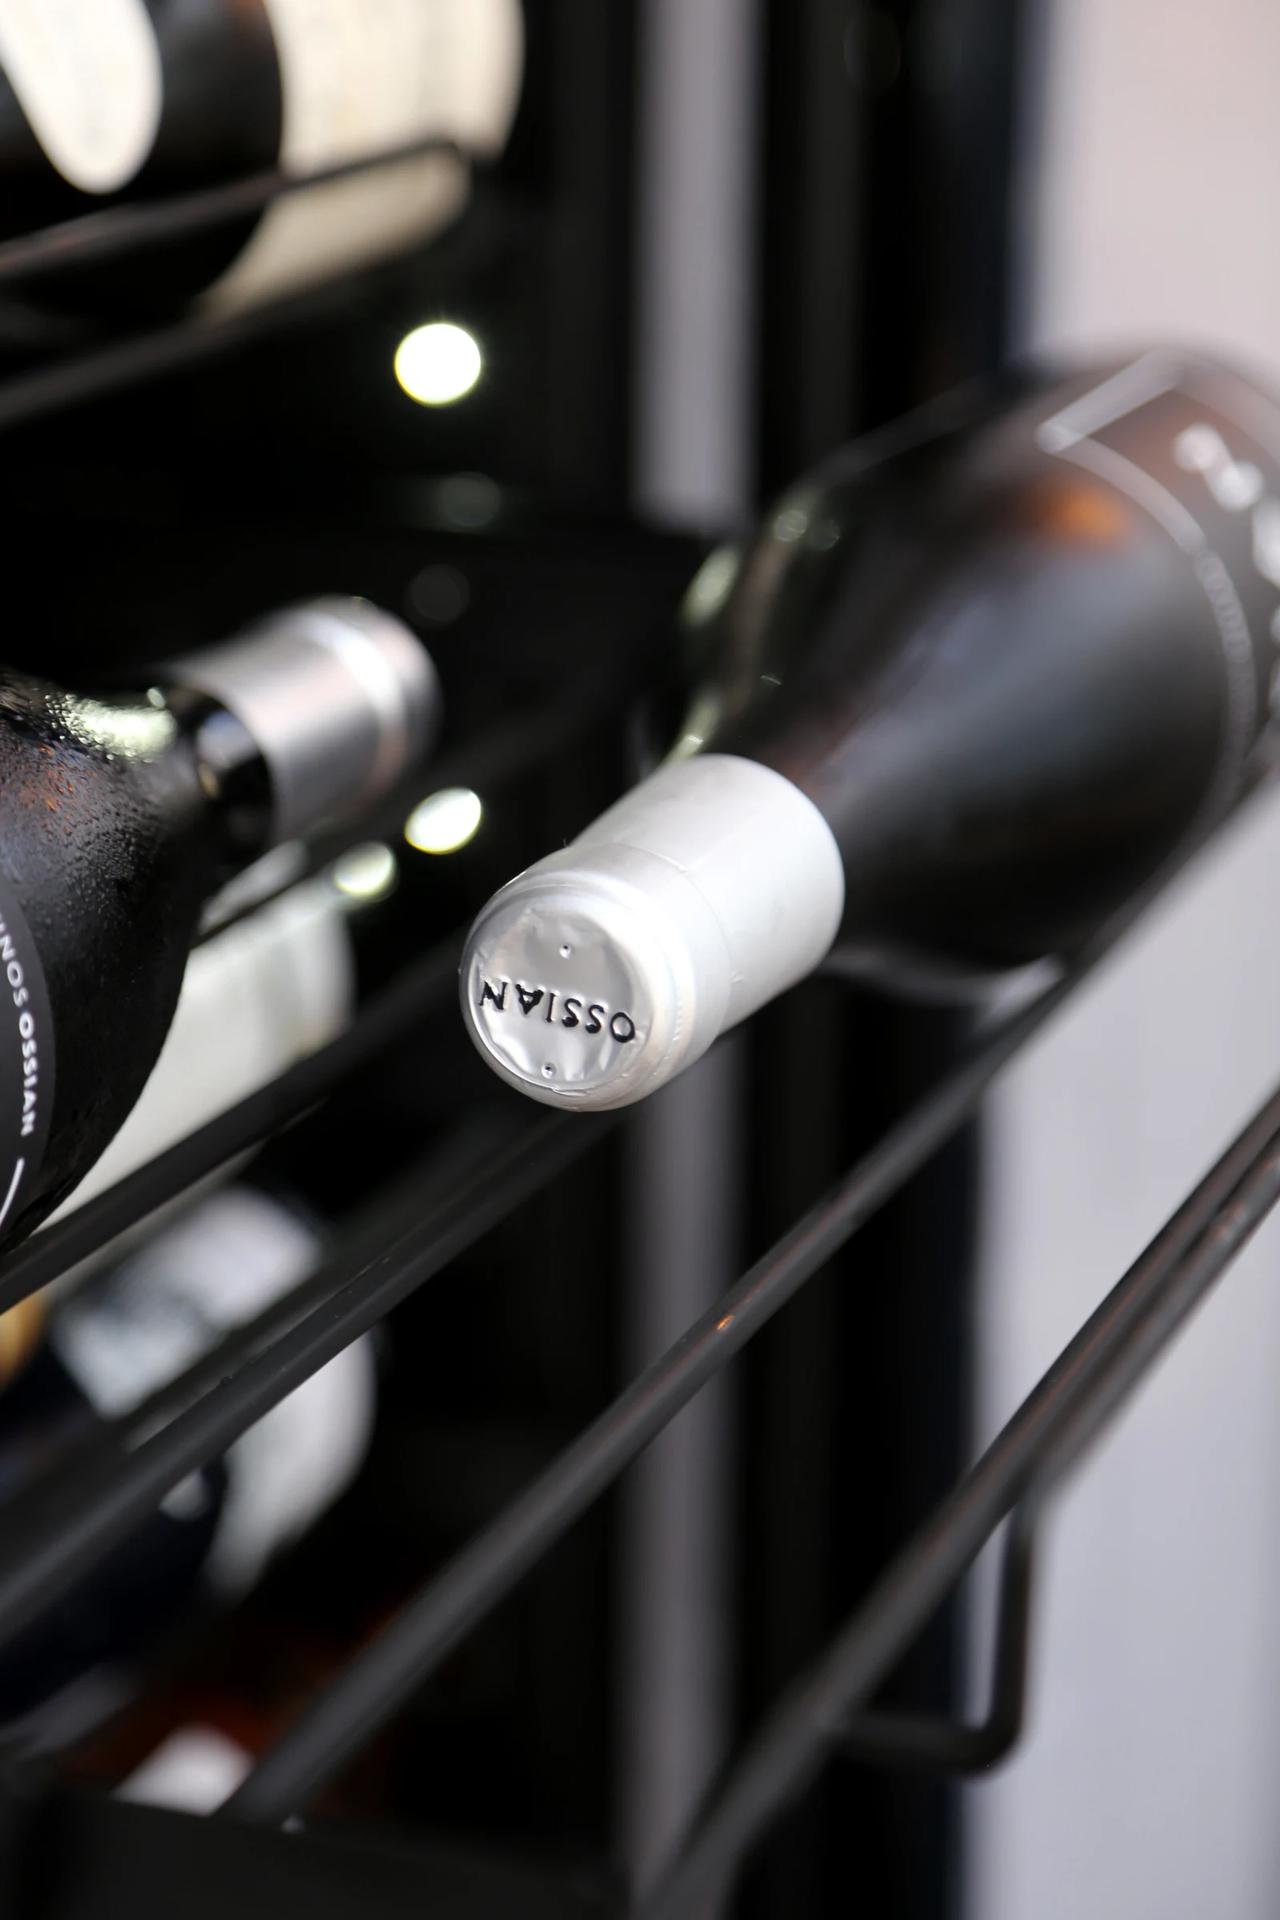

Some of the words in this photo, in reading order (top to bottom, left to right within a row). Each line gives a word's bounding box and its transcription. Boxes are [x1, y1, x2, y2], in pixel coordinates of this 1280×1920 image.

[0, 912, 28, 1007] NOS
[19, 1011, 38, 1136] OSSIAN
[479, 979, 636, 1043] OSSIAN
